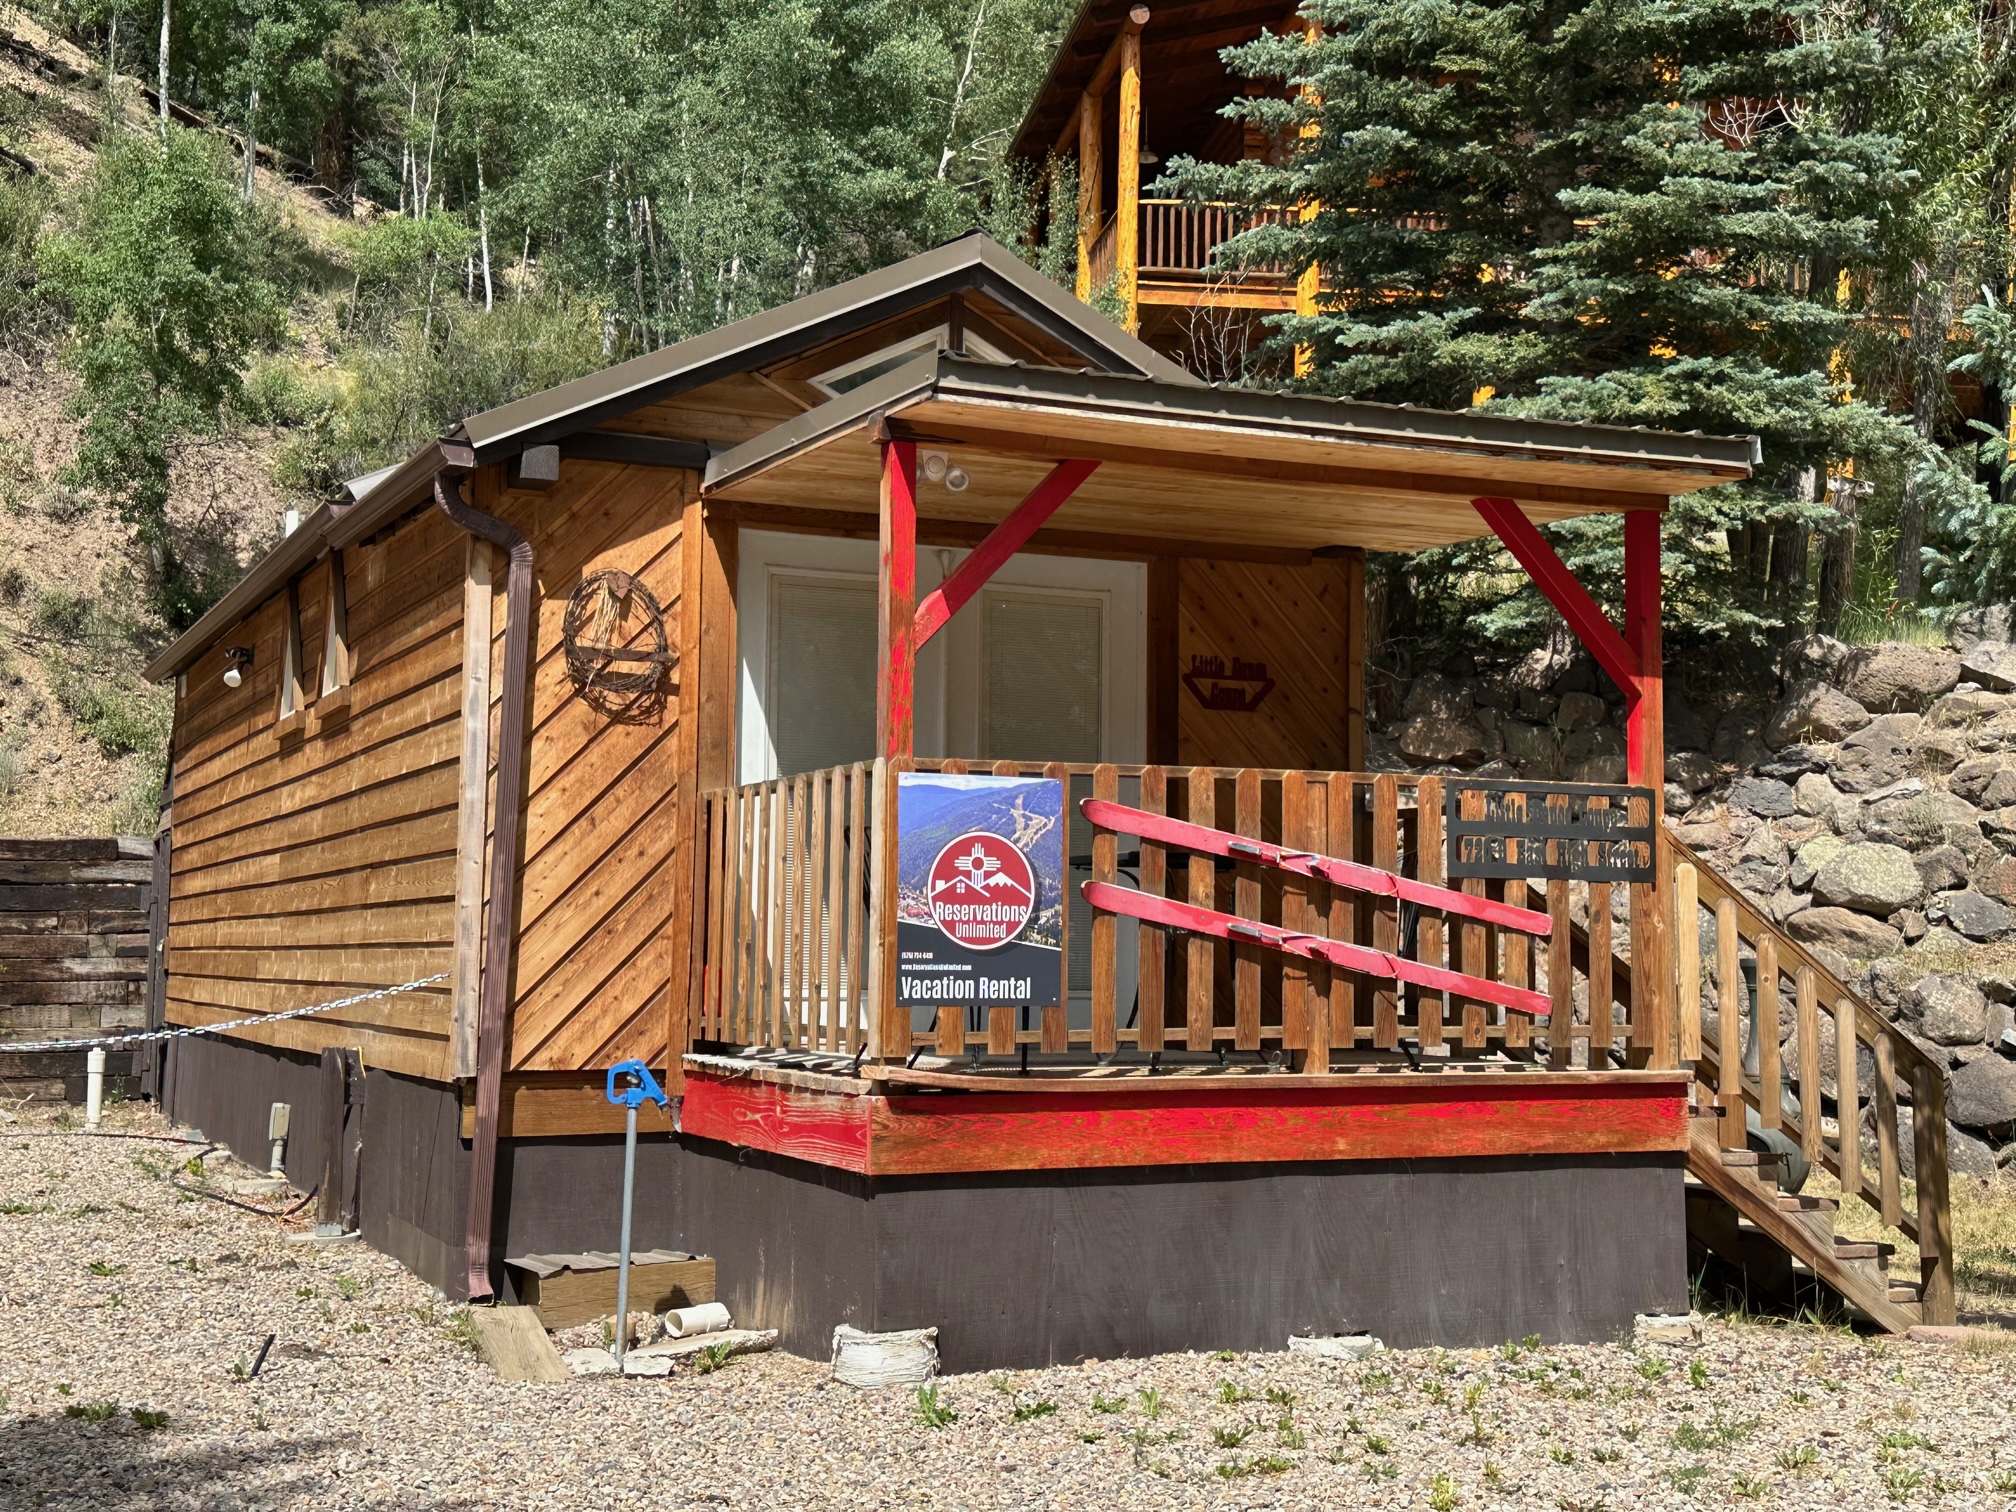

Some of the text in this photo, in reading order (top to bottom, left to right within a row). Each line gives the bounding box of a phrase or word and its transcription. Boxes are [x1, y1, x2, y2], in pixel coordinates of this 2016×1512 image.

[936, 902, 1027, 922] Reservations
[955, 922, 1007, 938] Unlimited
[901, 976, 1031, 1000] Vacation Rental
